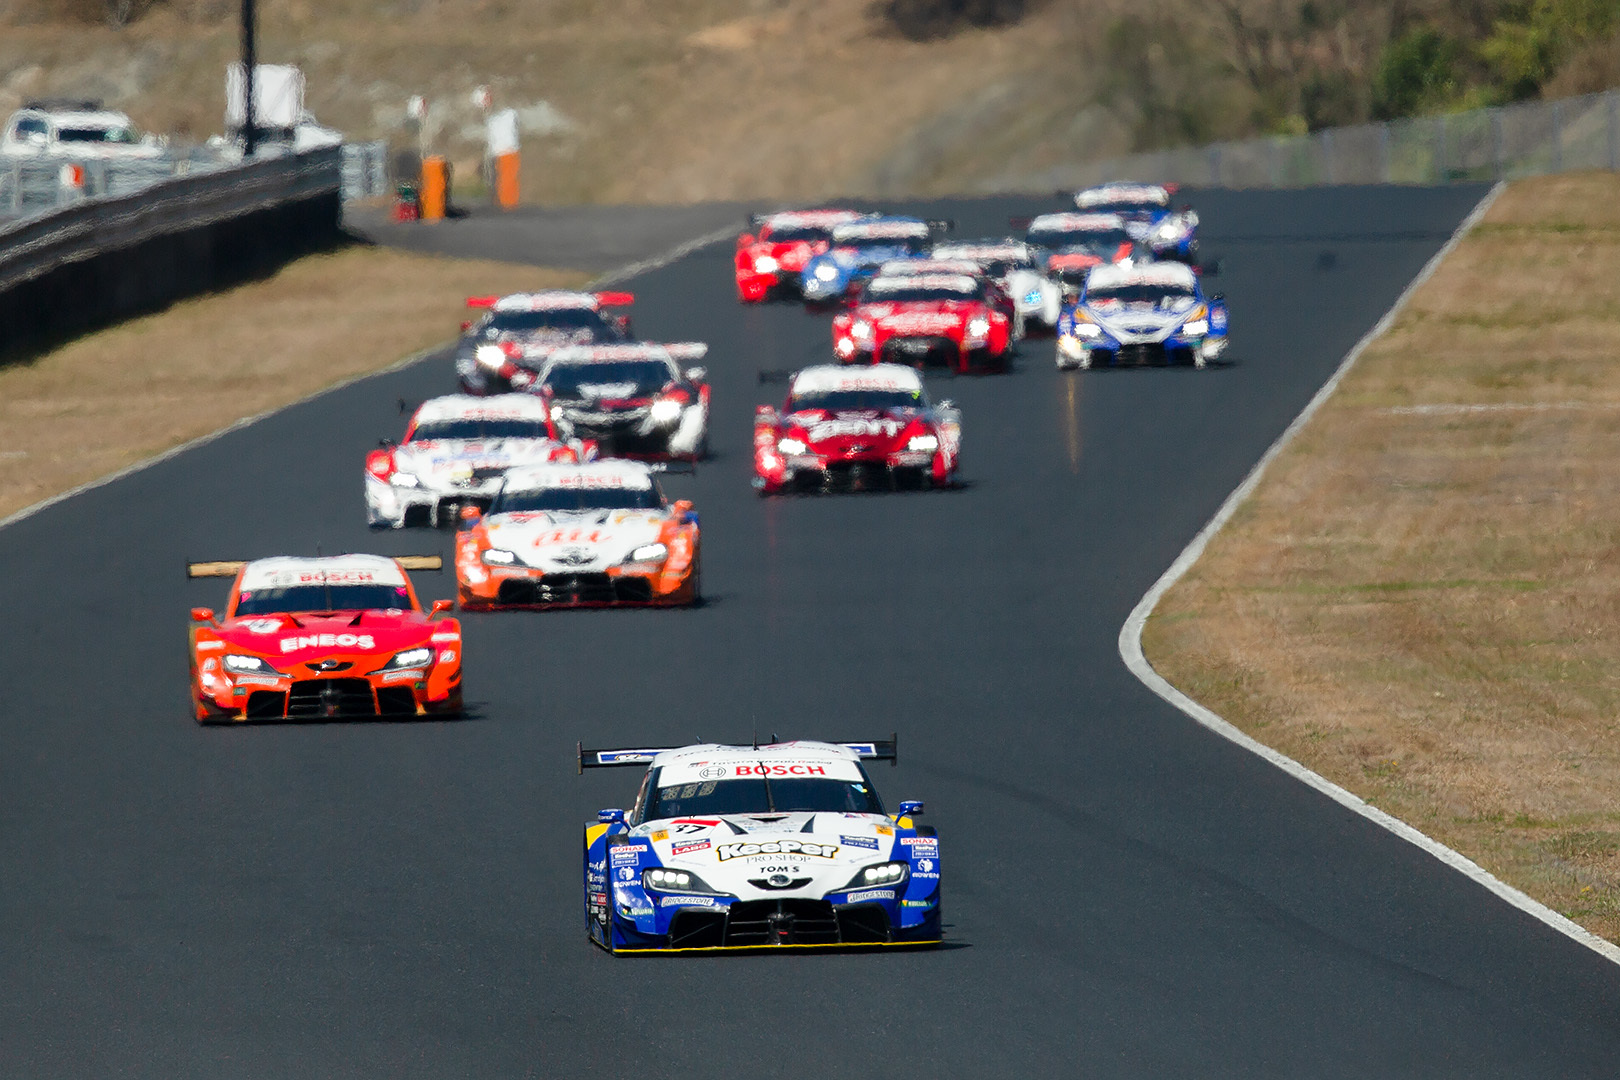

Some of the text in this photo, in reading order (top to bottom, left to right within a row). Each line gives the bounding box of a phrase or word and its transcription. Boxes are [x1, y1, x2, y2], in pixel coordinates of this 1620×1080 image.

[300, 571, 374, 583] BOSCH
[280, 634, 376, 653] ENEOS
[735, 765, 826, 776] BOSCH
[675, 843, 710, 854] LABO
[716, 839, 839, 862] KeePer
[775, 854, 811, 863] SHOP
